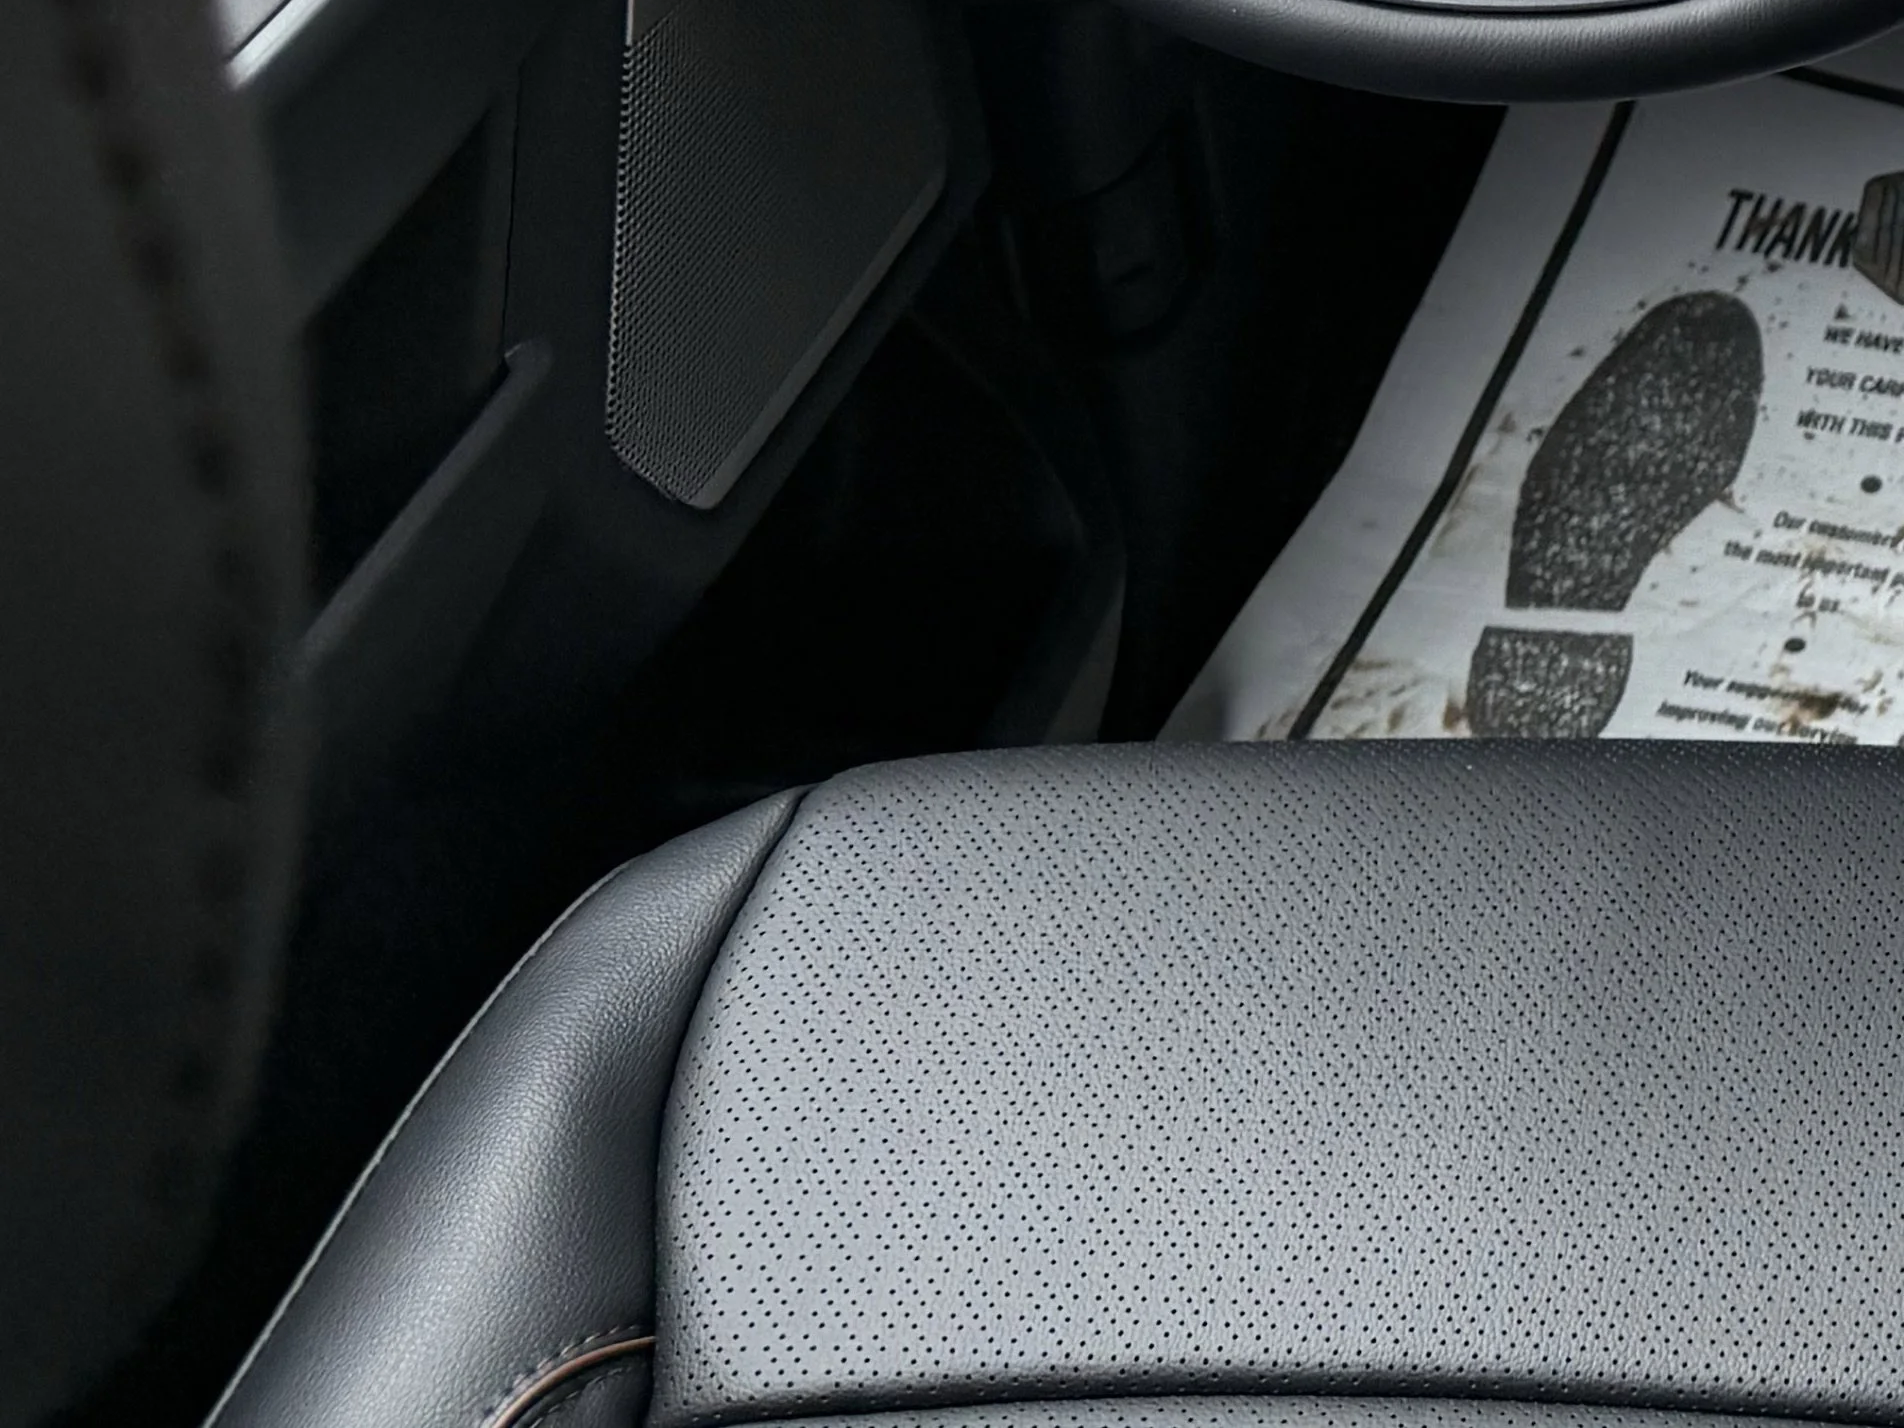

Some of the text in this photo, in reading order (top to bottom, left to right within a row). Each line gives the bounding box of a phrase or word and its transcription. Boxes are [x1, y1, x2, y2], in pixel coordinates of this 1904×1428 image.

[1716, 188, 1859, 268] THANK
[1823, 325, 1855, 344] WE
[1806, 365, 1857, 391] YOUR
[1797, 409, 1846, 435] WITH
[1849, 417, 1893, 441] THIS
